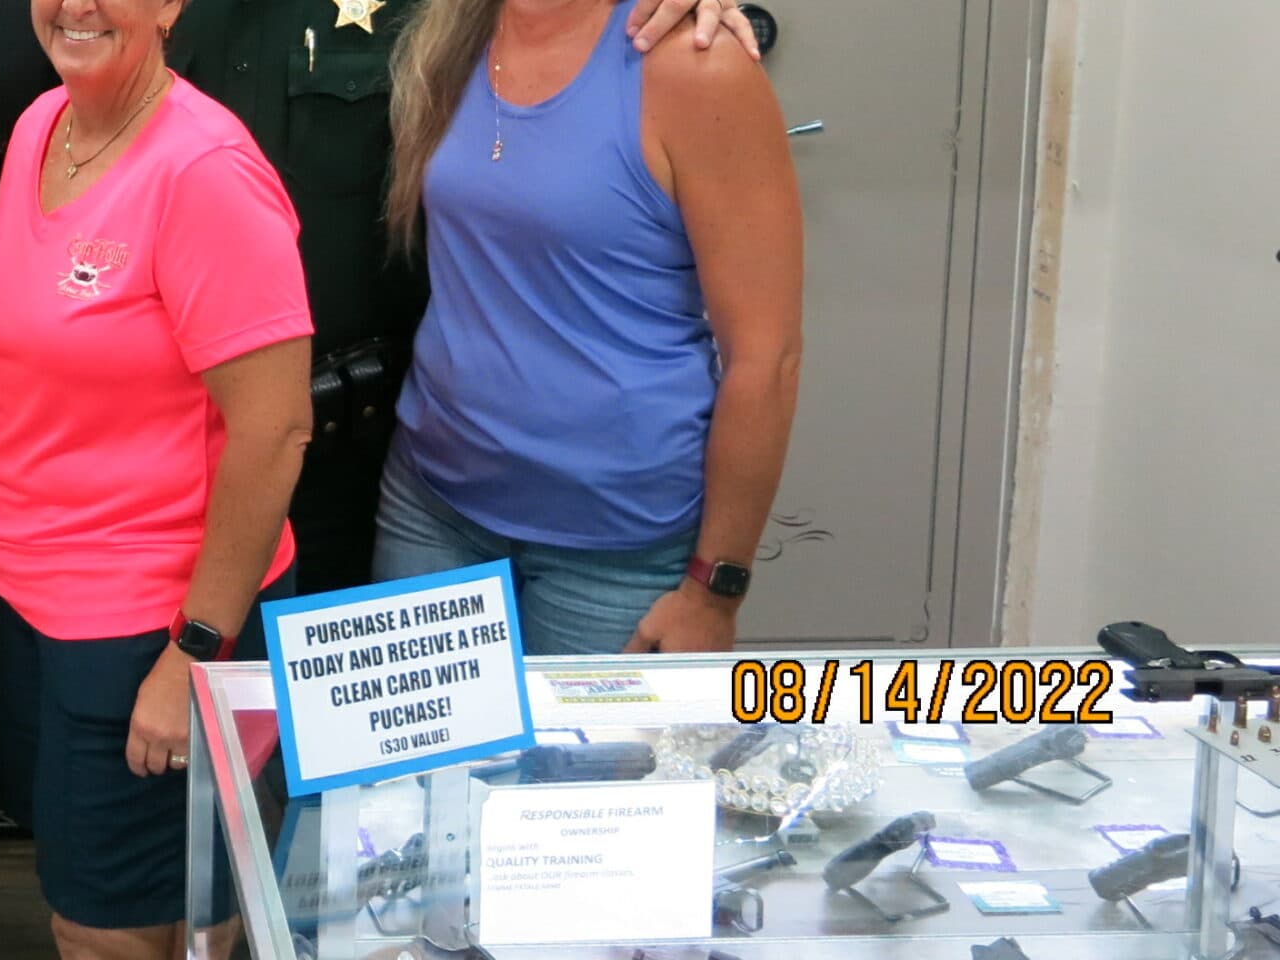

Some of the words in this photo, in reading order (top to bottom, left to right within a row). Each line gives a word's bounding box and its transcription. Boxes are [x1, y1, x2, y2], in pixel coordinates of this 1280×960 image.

[304, 611, 395, 646] PURCHASE
[400, 608, 411, 629] A
[413, 594, 485, 626] FIREARM
[288, 652, 345, 681] TODAY
[349, 645, 384, 670] AND
[386, 630, 454, 663] RECEIVE
[458, 629, 469, 649] A
[472, 621, 508, 647] FREE
[330, 677, 383, 707] CLEAN
[386, 668, 433, 696] CARD
[434, 659, 481, 685] WITH
[369, 696, 452, 732] PUCHASE!
[521, 808, 604, 821] RESPONSIBLE
[608, 805, 664, 818] FIREARM
[560, 826, 620, 838] OWNERSHIP
[486, 855, 538, 869] QUALITY
[542, 854, 603, 865] TRAINING
